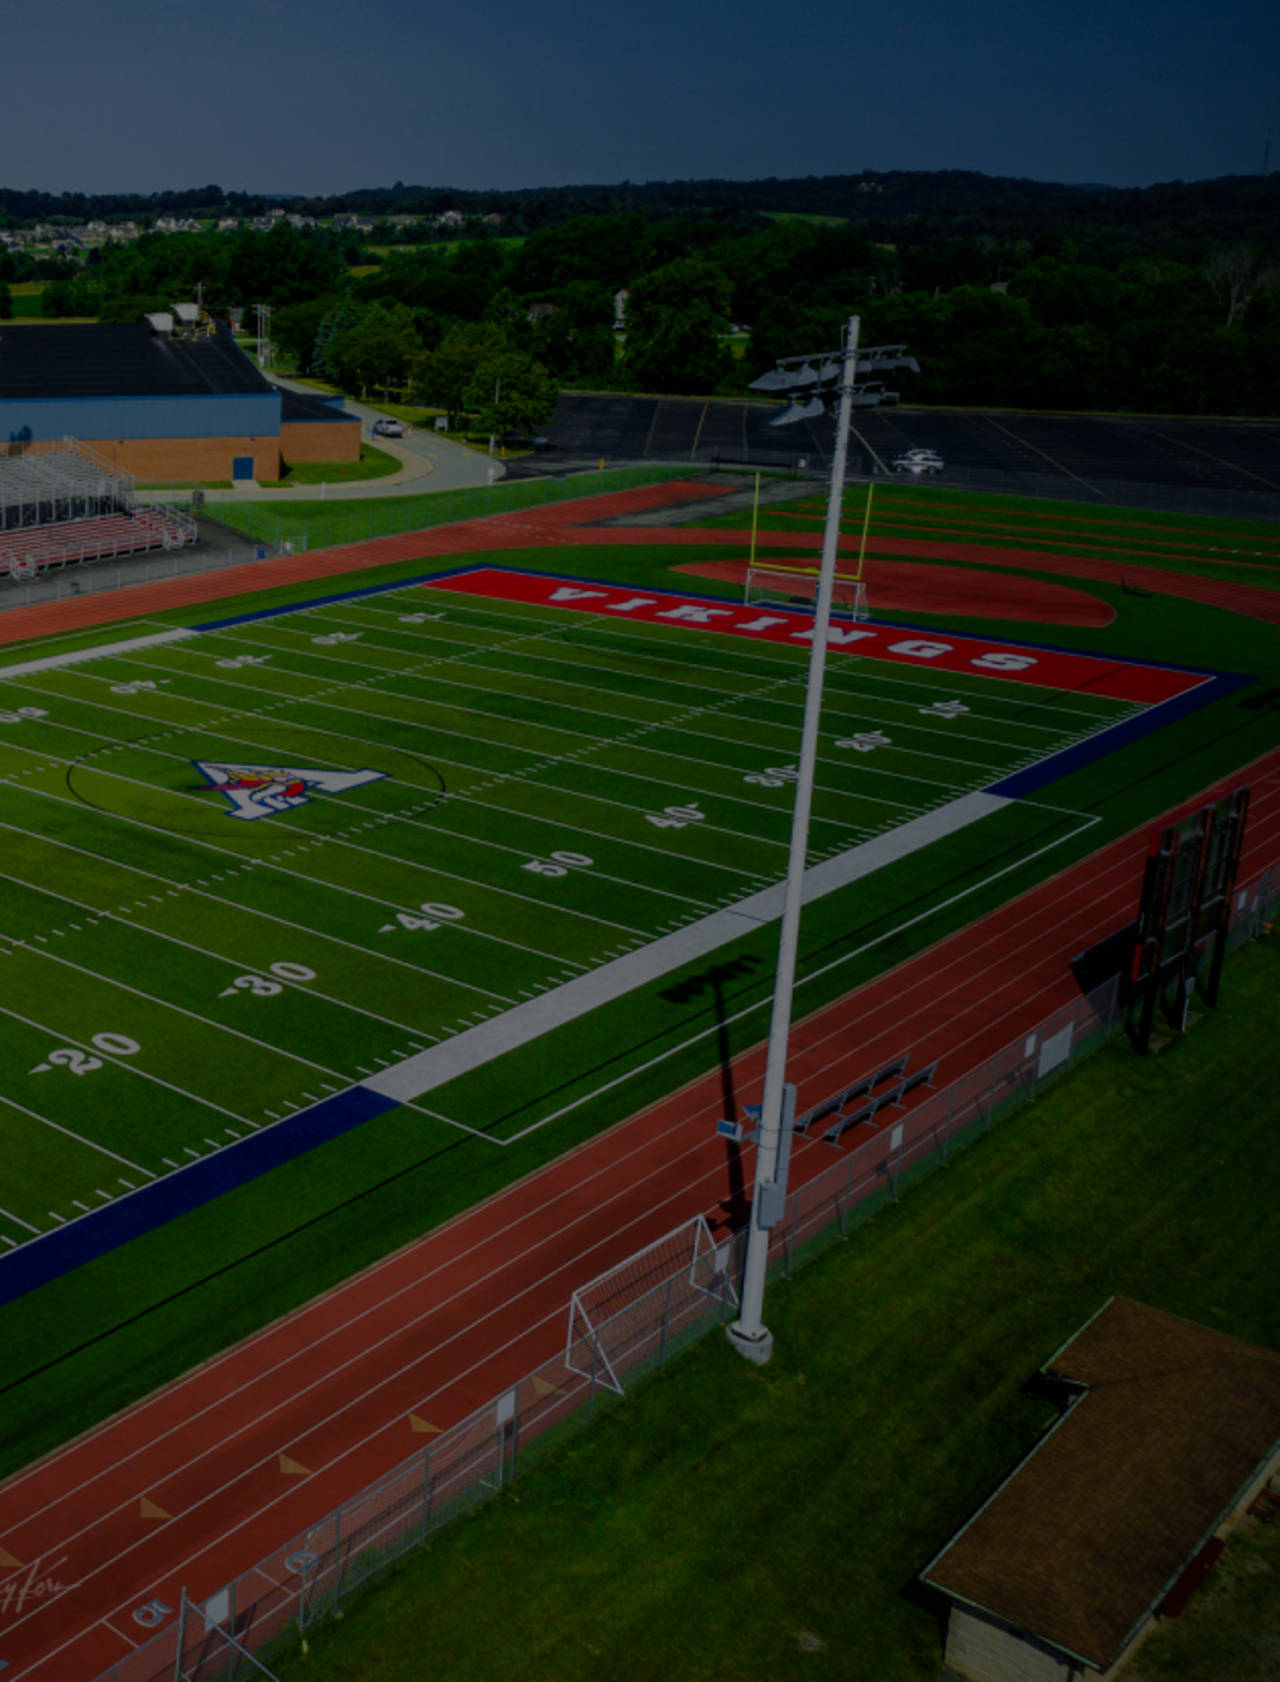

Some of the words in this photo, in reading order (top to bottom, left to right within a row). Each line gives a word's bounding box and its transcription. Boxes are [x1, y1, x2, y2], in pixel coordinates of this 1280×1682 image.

[546, 585, 1041, 672] VIKINGS
[644, 805, 706, 828] 40
[520, 850, 595, 877] 50
[395, 901, 465, 931] 40
[231, 962, 318, 997] 30
[47, 1032, 141, 1076] 20
